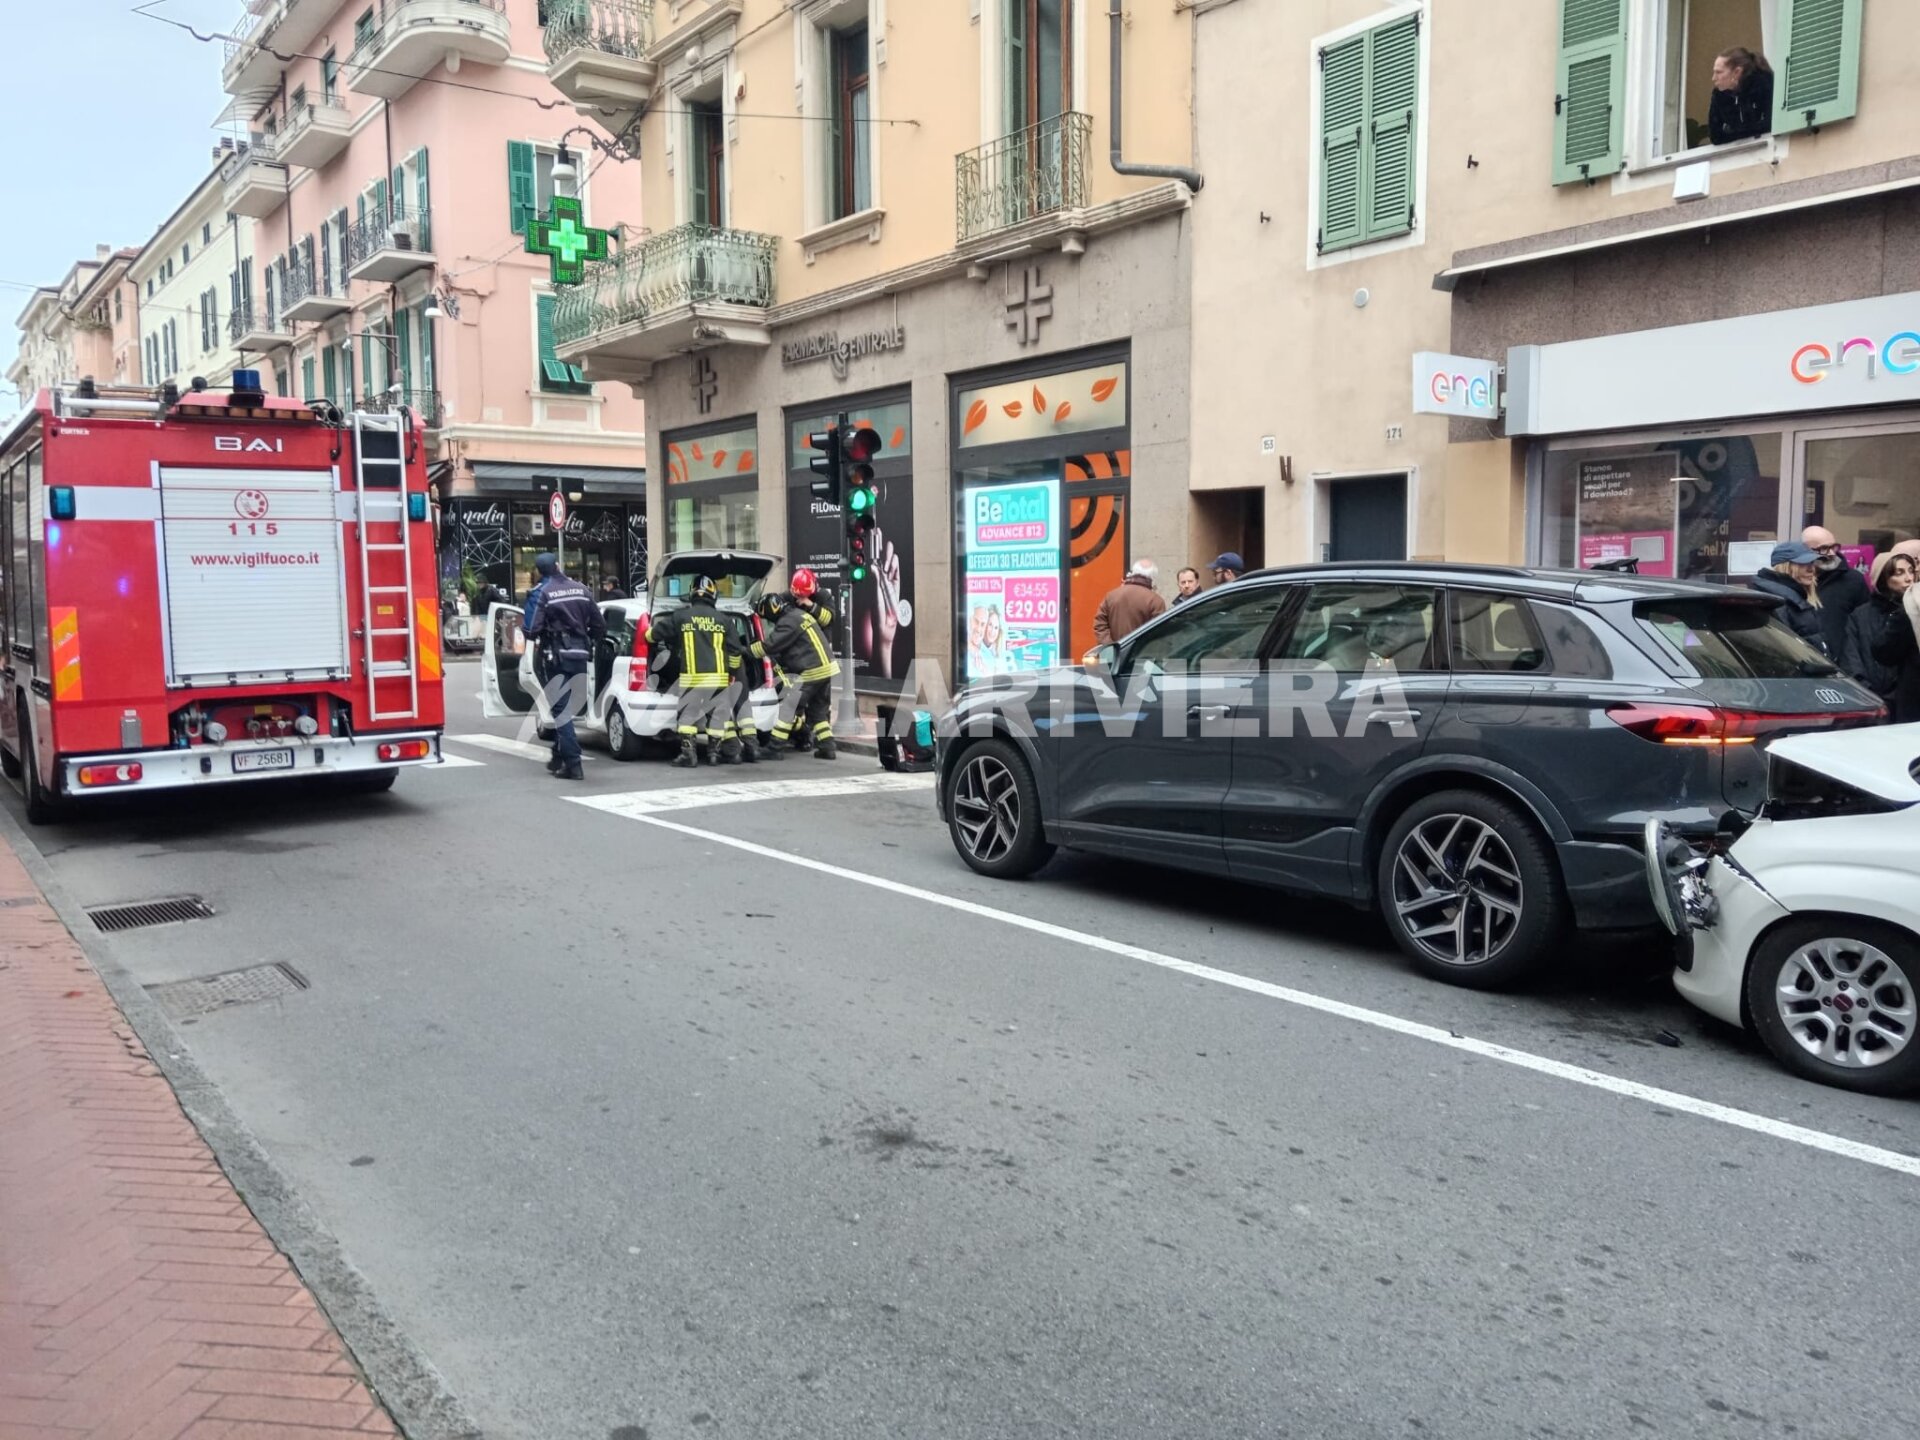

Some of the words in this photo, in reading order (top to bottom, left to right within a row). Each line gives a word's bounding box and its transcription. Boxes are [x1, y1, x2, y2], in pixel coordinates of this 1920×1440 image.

[839, 325, 905, 360] CENTRALE
[1430, 368, 1494, 408] enel
[214, 436, 283, 453] BAI
[462, 502, 506, 525] nadia
[980, 526, 1025, 540] ADVANCE
[1026, 524, 1042, 537] B12
[191, 552, 320, 569] www.vigilfuoco.it
[968, 554, 999, 569] OFFERTA
[1000, 553, 1010, 568] 30
[1011, 551, 1057, 568] FLACONCINI
[1013, 582, 1049, 598] €34.55
[1005, 599, 1057, 619] €29.90
[237, 755, 249, 767] VF
[257, 752, 290, 766] 25681
